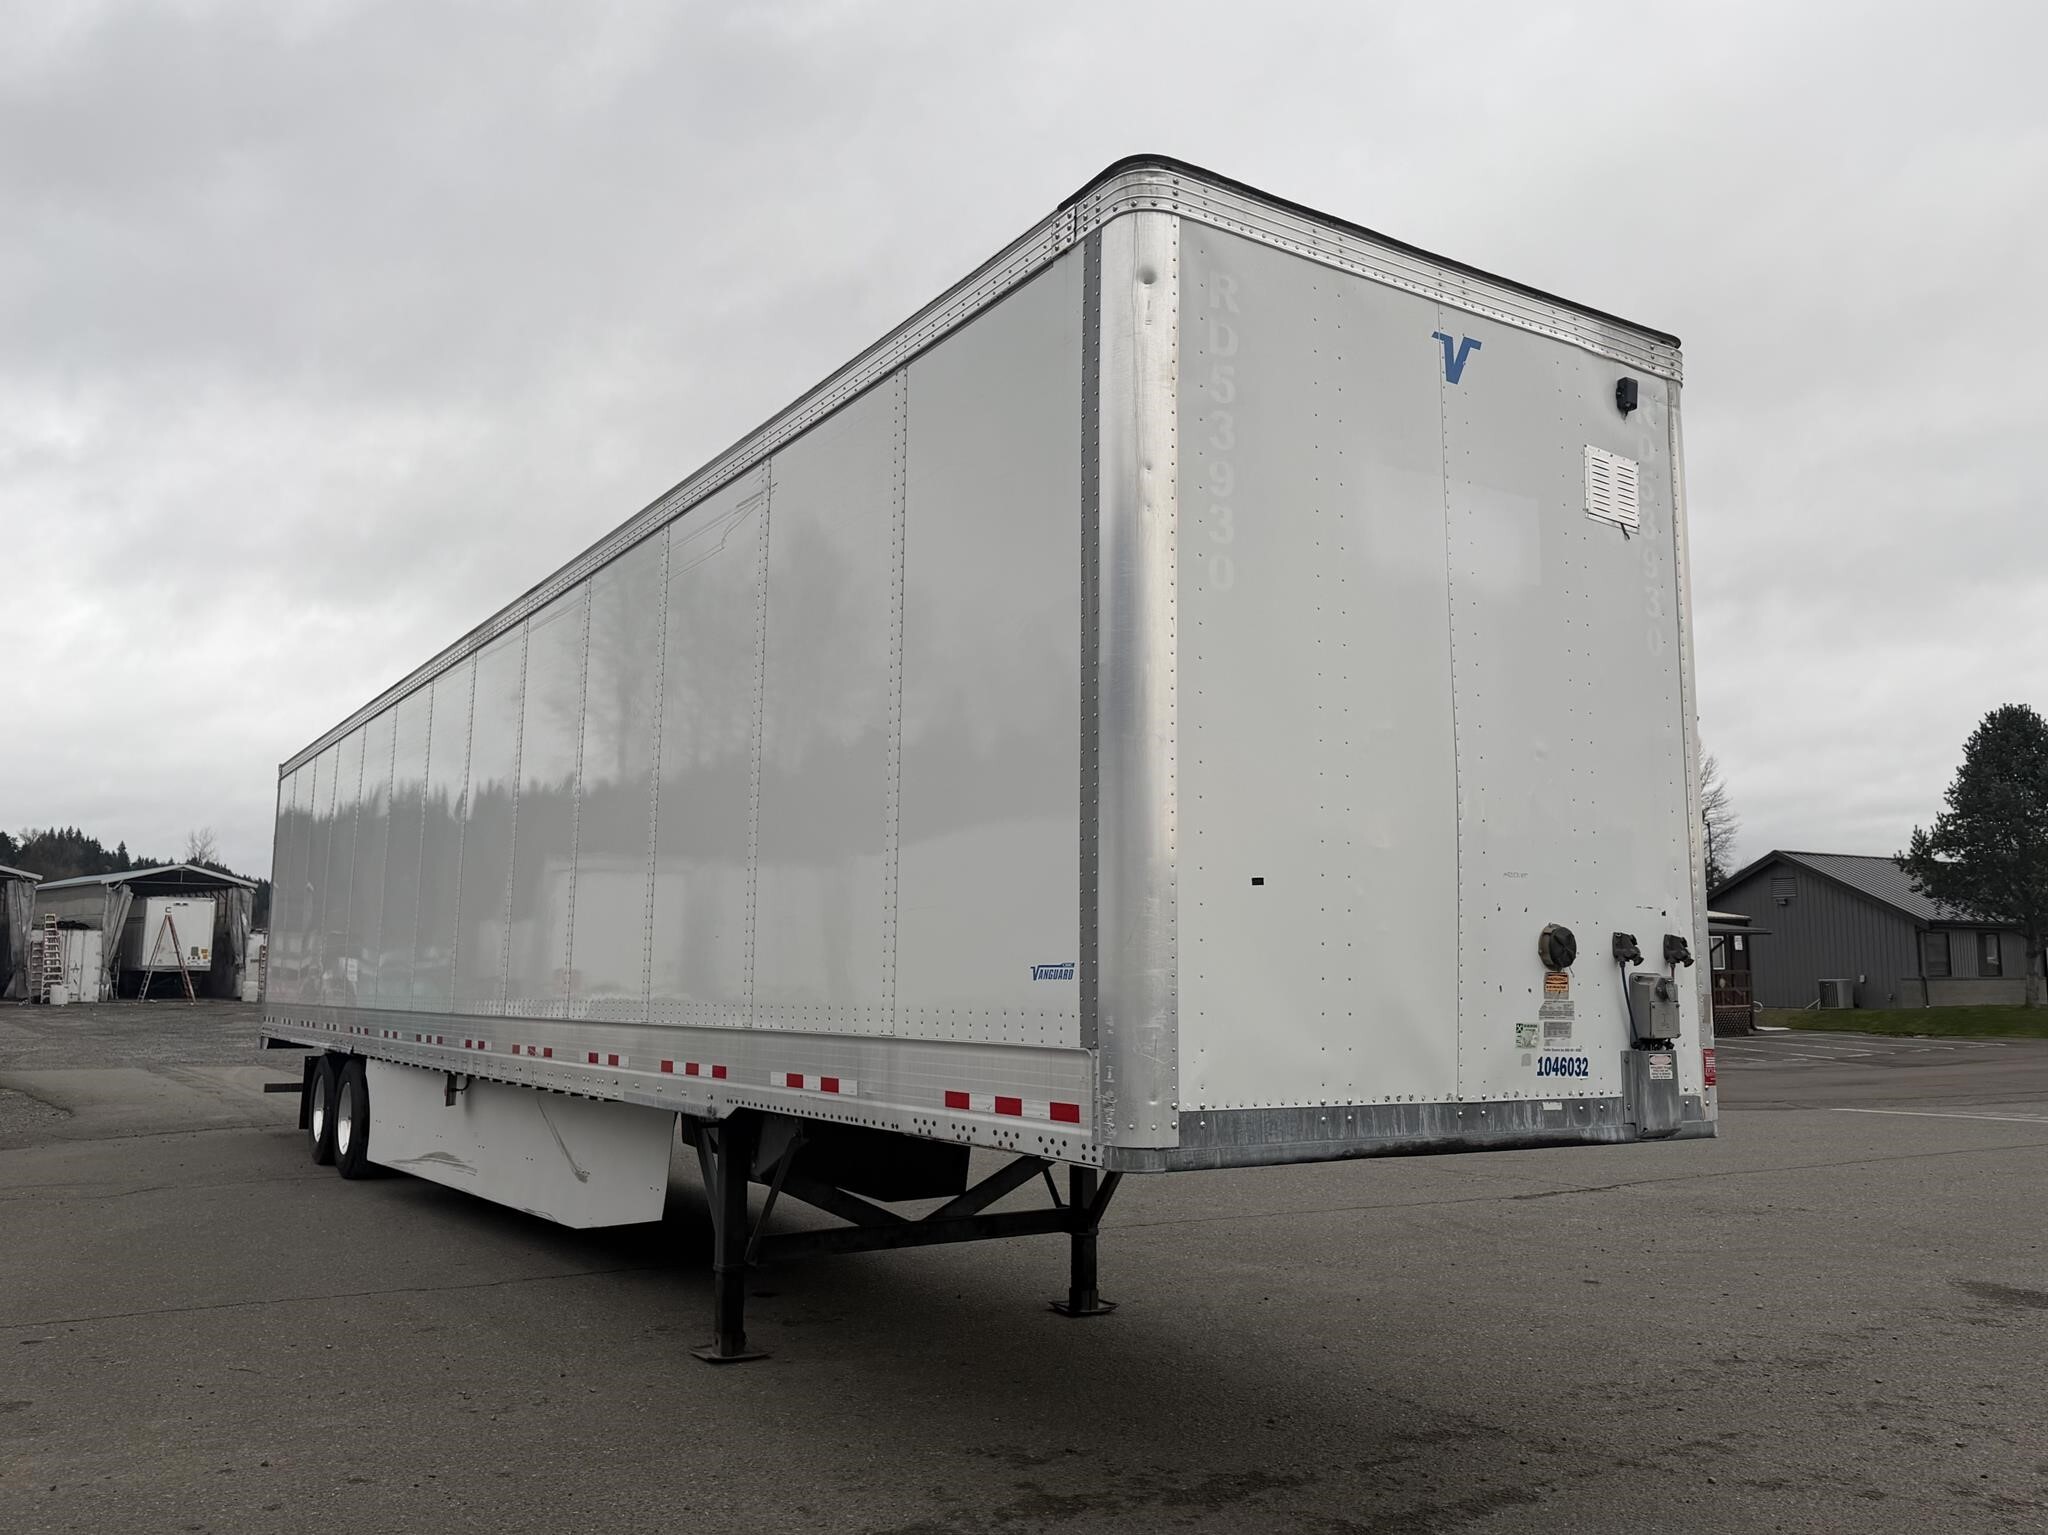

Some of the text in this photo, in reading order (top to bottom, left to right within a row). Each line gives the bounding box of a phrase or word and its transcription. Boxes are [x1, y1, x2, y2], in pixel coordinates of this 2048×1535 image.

[1431, 331, 1482, 385] V
[1030, 963, 1074, 981] VANGUARD
[1536, 1056, 1589, 1077] 1046032
